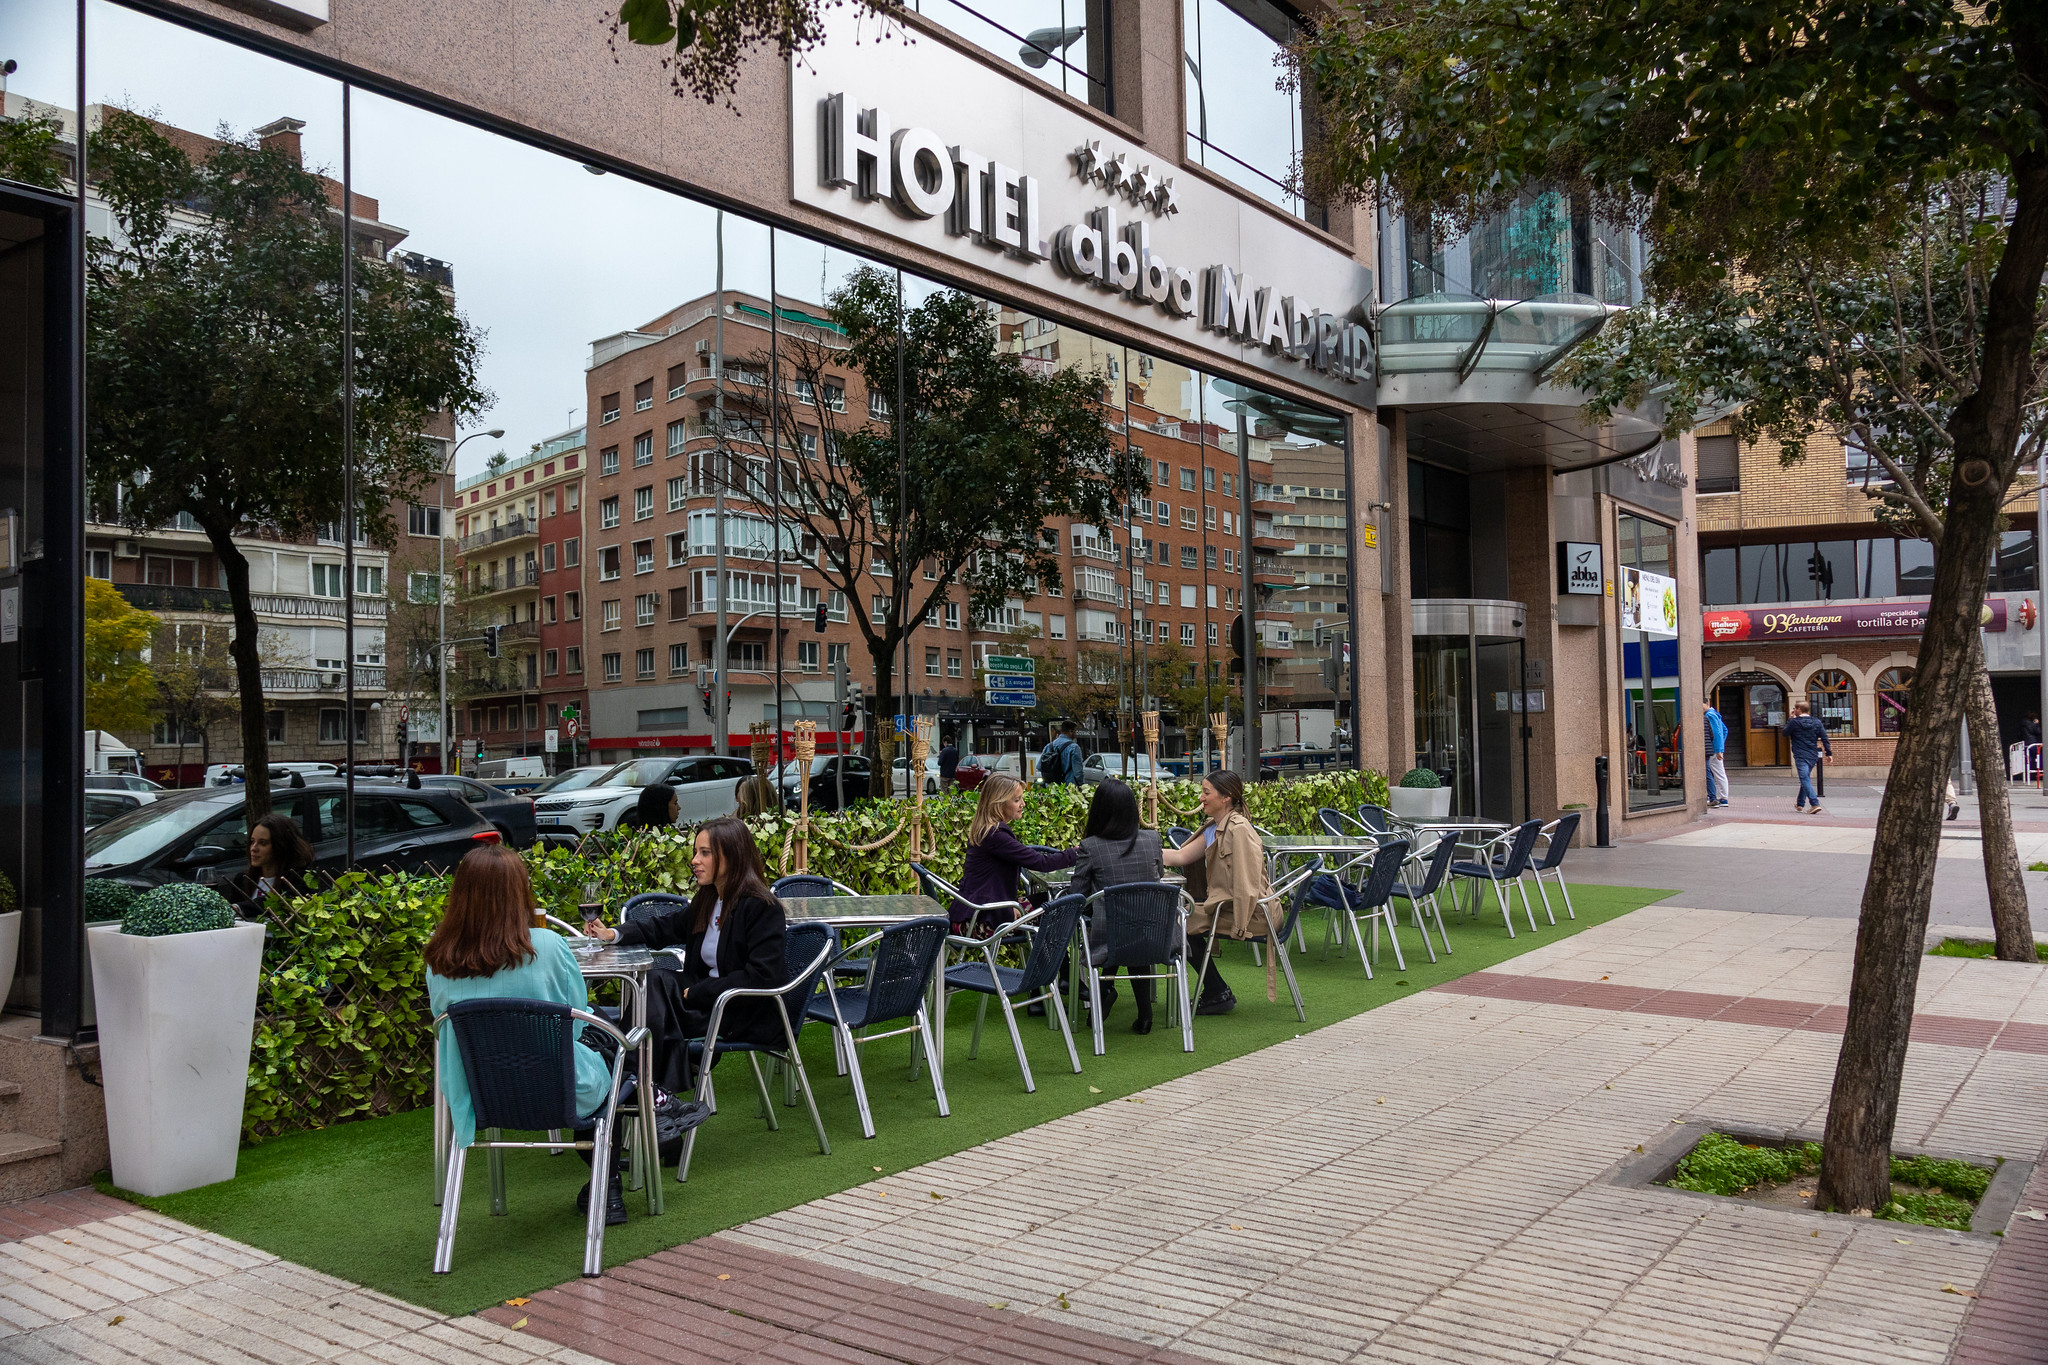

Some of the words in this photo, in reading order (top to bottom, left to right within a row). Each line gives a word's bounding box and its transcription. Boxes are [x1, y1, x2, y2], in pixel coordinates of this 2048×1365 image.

[825, 91, 1050, 263] HOTEL
[1055, 206, 1198, 318] abba
[1205, 263, 1376, 384] MADRID
[1571, 565, 1598, 581] abba
[1763, 613, 1789, 635] 93
[1787, 613, 1842, 627] Cartagena
[1788, 625, 1829, 633] CAFETERÍA
[1856, 617, 1892, 628] tortilla
[1894, 616, 1909, 626] de
